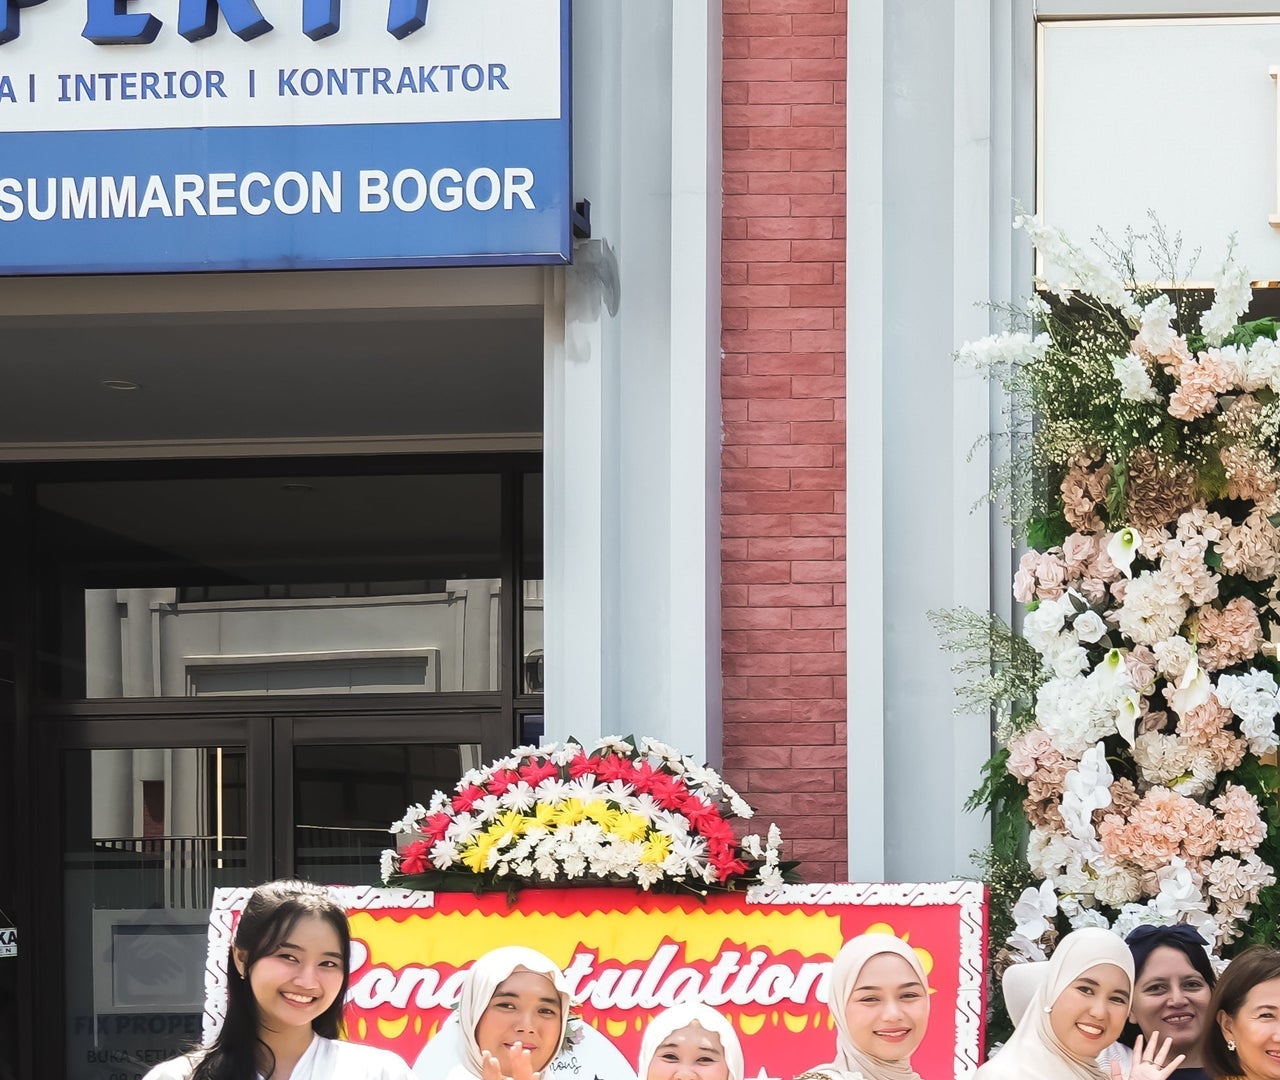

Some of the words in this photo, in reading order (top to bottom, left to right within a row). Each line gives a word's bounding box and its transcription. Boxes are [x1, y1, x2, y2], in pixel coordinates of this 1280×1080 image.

[57, 70, 227, 102] INTERIOR
[277, 63, 510, 97] KONTRAKTOR
[0, 170, 342, 222] SUMMARECON
[359, 167, 536, 214] BOGOR
[115, 1014, 198, 1034] PROPE
